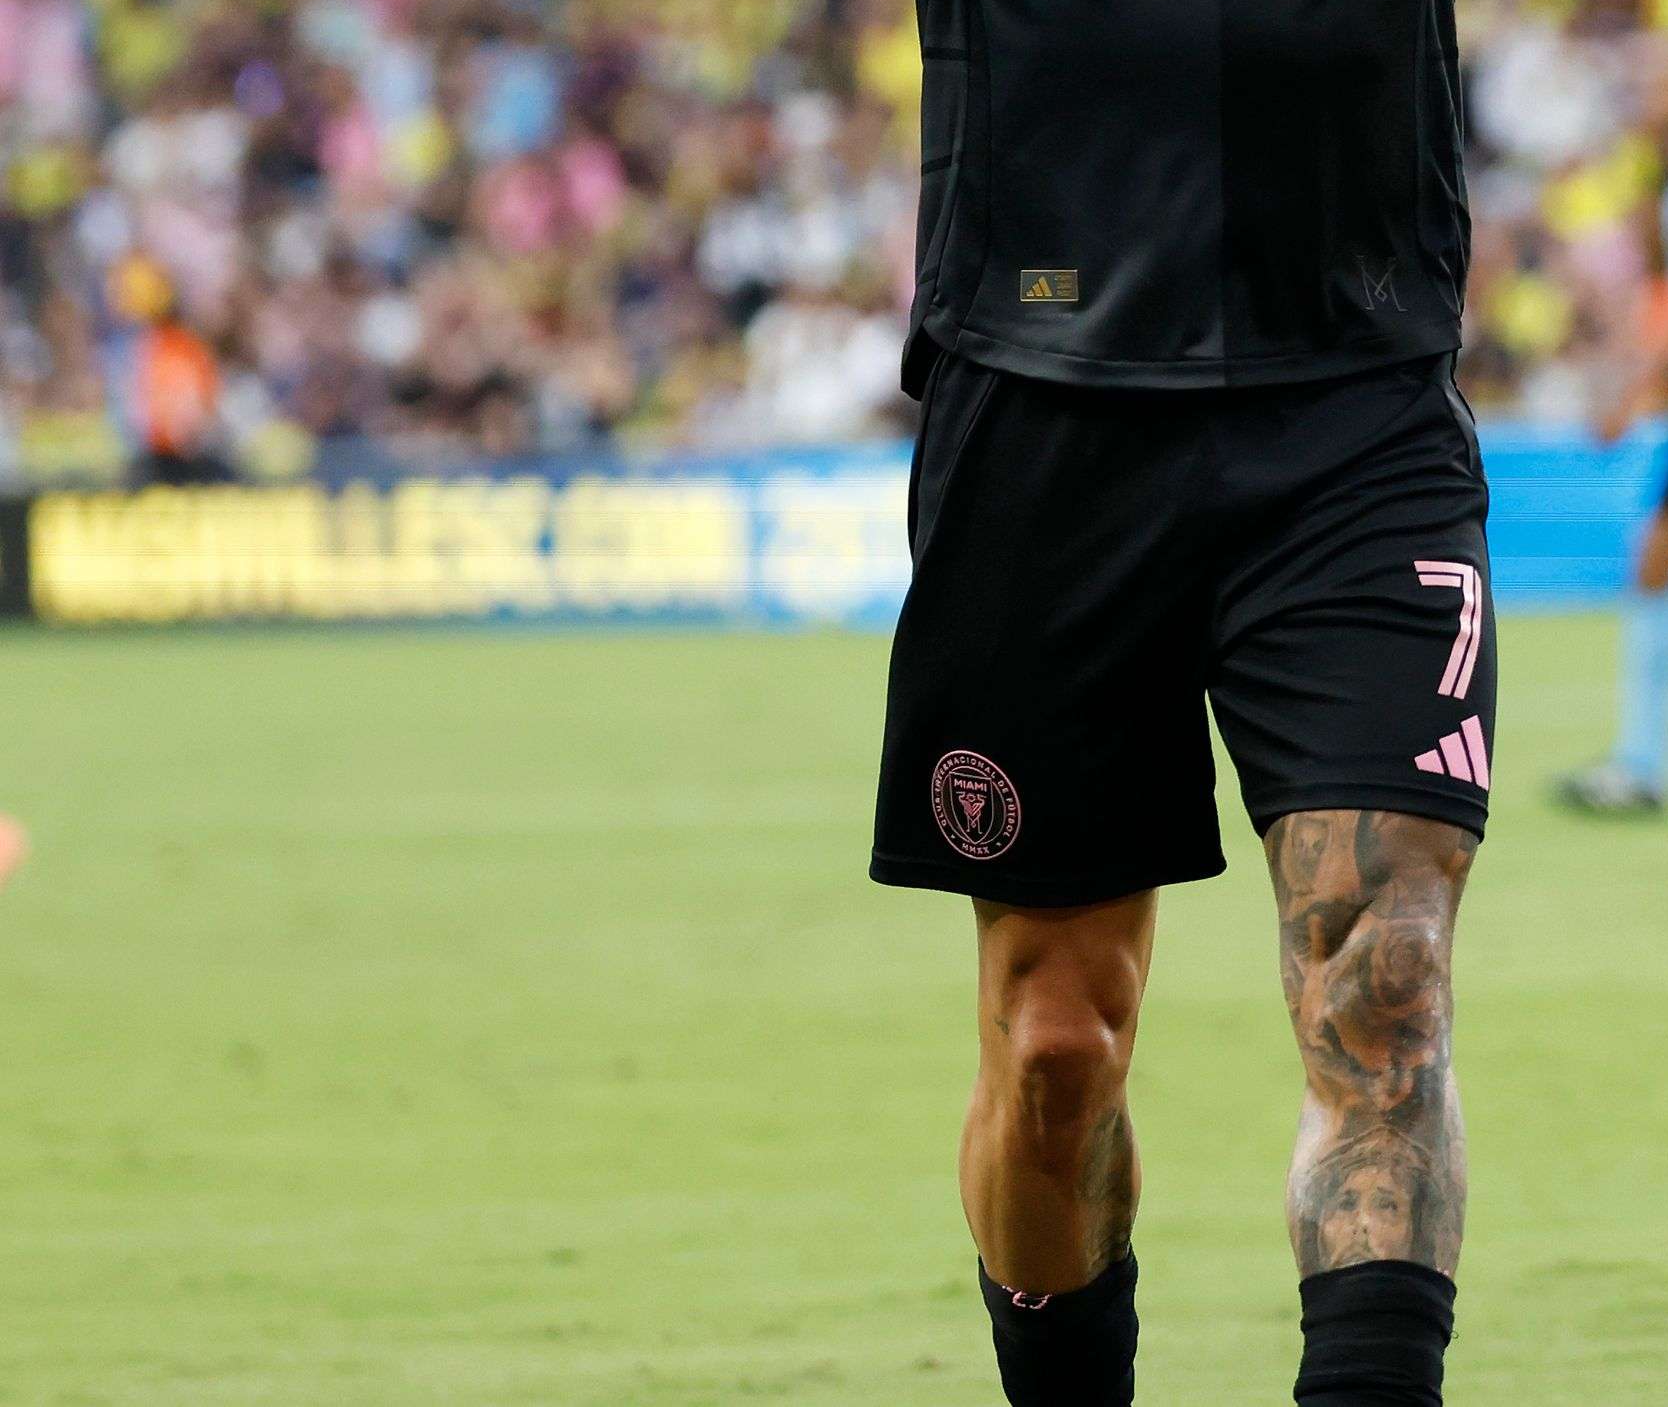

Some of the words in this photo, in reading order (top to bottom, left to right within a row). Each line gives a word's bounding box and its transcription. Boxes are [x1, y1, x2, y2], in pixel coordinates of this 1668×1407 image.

[1413, 560, 1482, 700] 7
[953, 778, 988, 793] MIAMI
[997, 780, 1009, 793] DE
[961, 843, 991, 855] MMXX
